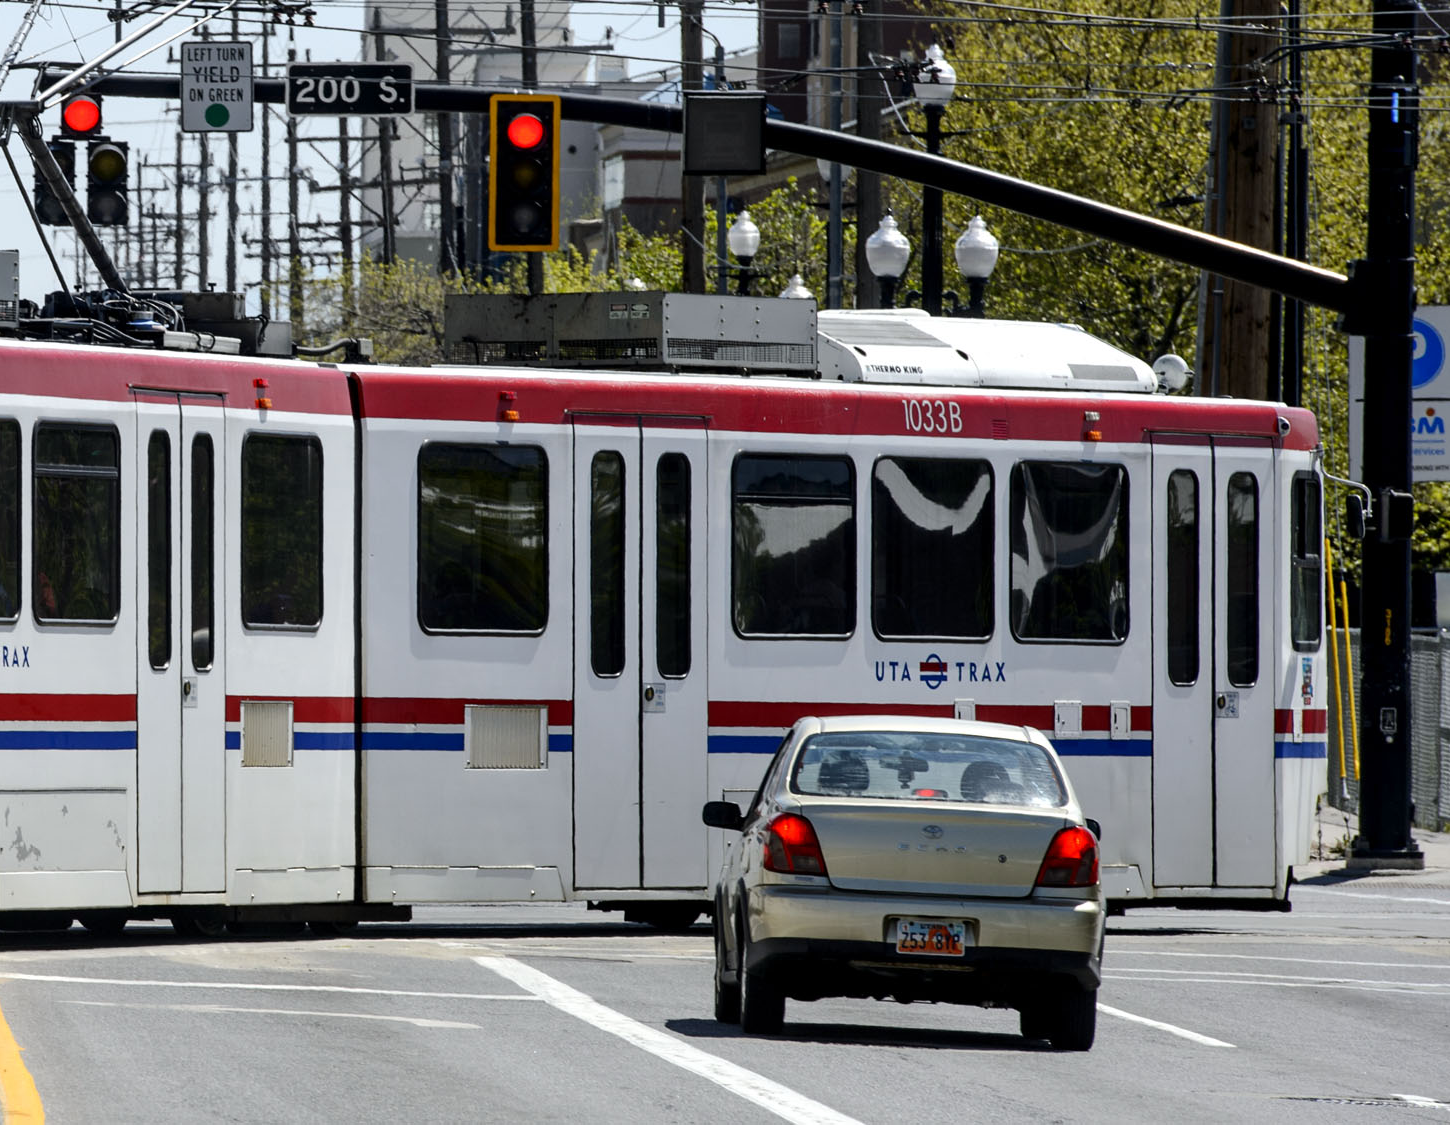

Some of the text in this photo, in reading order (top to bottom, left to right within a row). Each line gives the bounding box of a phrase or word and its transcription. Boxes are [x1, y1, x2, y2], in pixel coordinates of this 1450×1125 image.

[187, 47, 245, 62] LEFT TURN
[193, 66, 240, 84] YIELD
[189, 87, 244, 102] ON GREEN
[295, 75, 405, 104] 200 S.
[870, 364, 924, 375] THERMO KING
[901, 399, 963, 434] 1033B
[1413, 448, 1445, 456] ervices
[875, 661, 1006, 682] UTA TRAX
